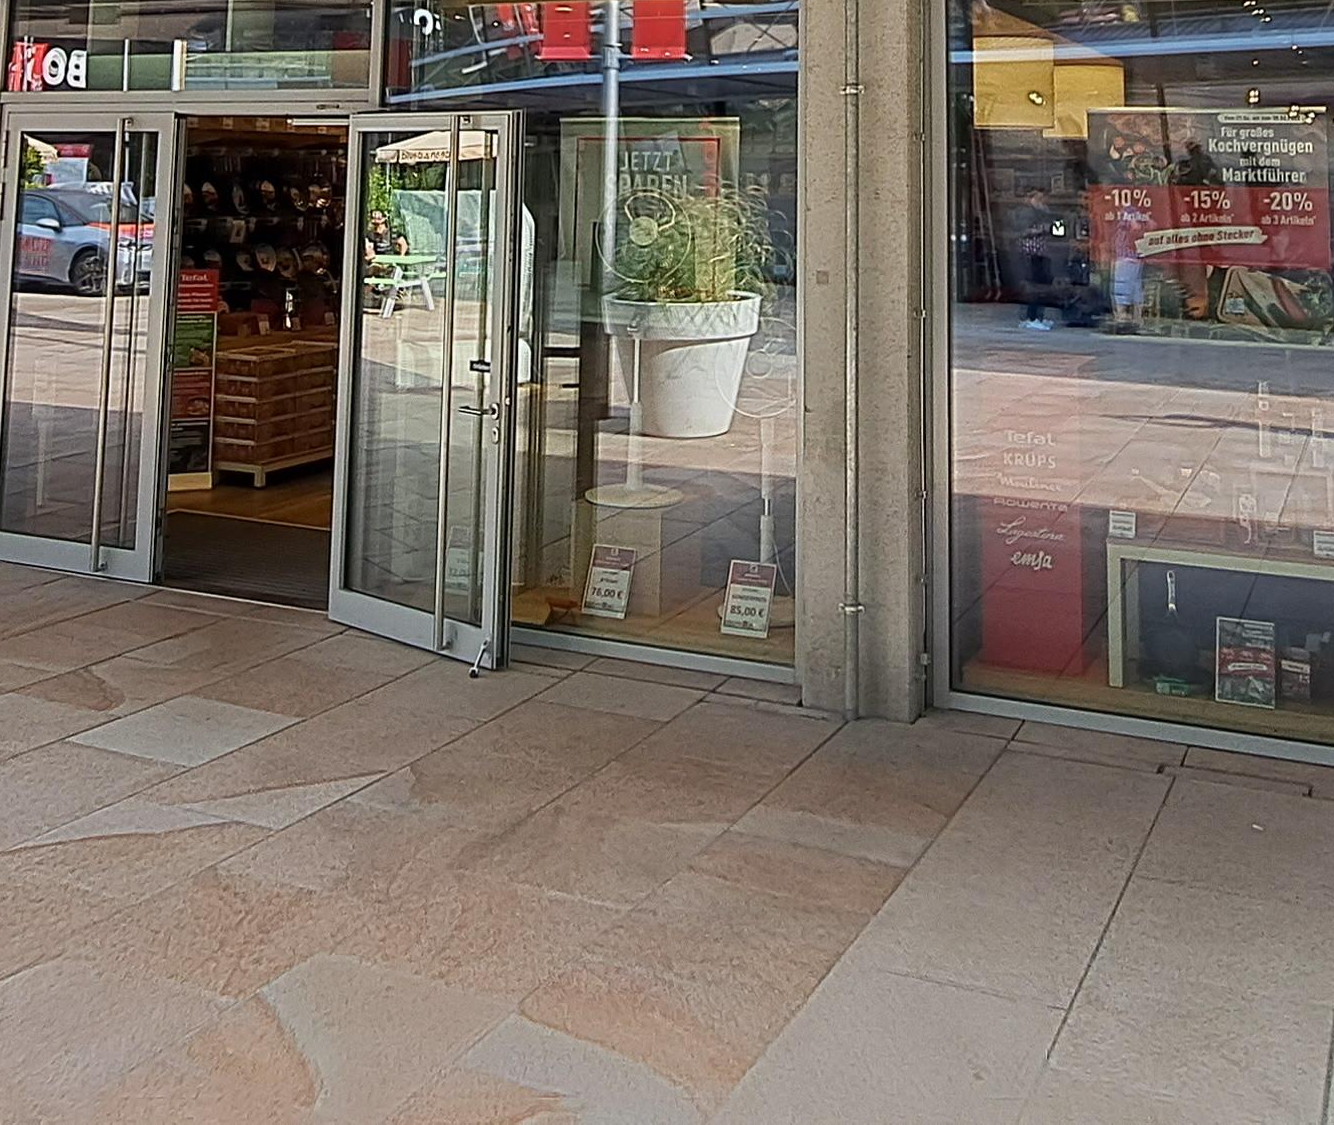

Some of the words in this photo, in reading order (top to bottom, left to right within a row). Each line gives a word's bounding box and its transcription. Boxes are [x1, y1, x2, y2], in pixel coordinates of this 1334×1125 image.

[1220, 126, 1237, 137] Für
[1239, 127, 1274, 139] großes
[1208, 138, 1314, 156] Kochvergnügen
[619, 150, 674, 172] JETZT
[1239, 156, 1256, 166] mit
[1258, 156, 1281, 166] dem
[1104, 189, 1152, 208] -10%
[1183, 190, 1231, 210] -15%
[1263, 191, 1313, 212] -20%
[1104, 211, 1115, 221] ab
[1180, 213, 1191, 222] ab
[1192, 213, 1197, 222] 2
[1261, 215, 1271, 225] ab
[1272, 216, 1278, 225] 3
[1148, 235, 1164, 246] auf
[1166, 233, 1189, 244] alles
[1191, 232, 1215, 242] ohne
[1216, 229, 1255, 241] Stecker
[1004, 430, 1057, 446] Tefal
[1003, 452, 1057, 469] KRUPS
[730, 604, 757, 617] 85,00
[758, 606, 765, 618] €
